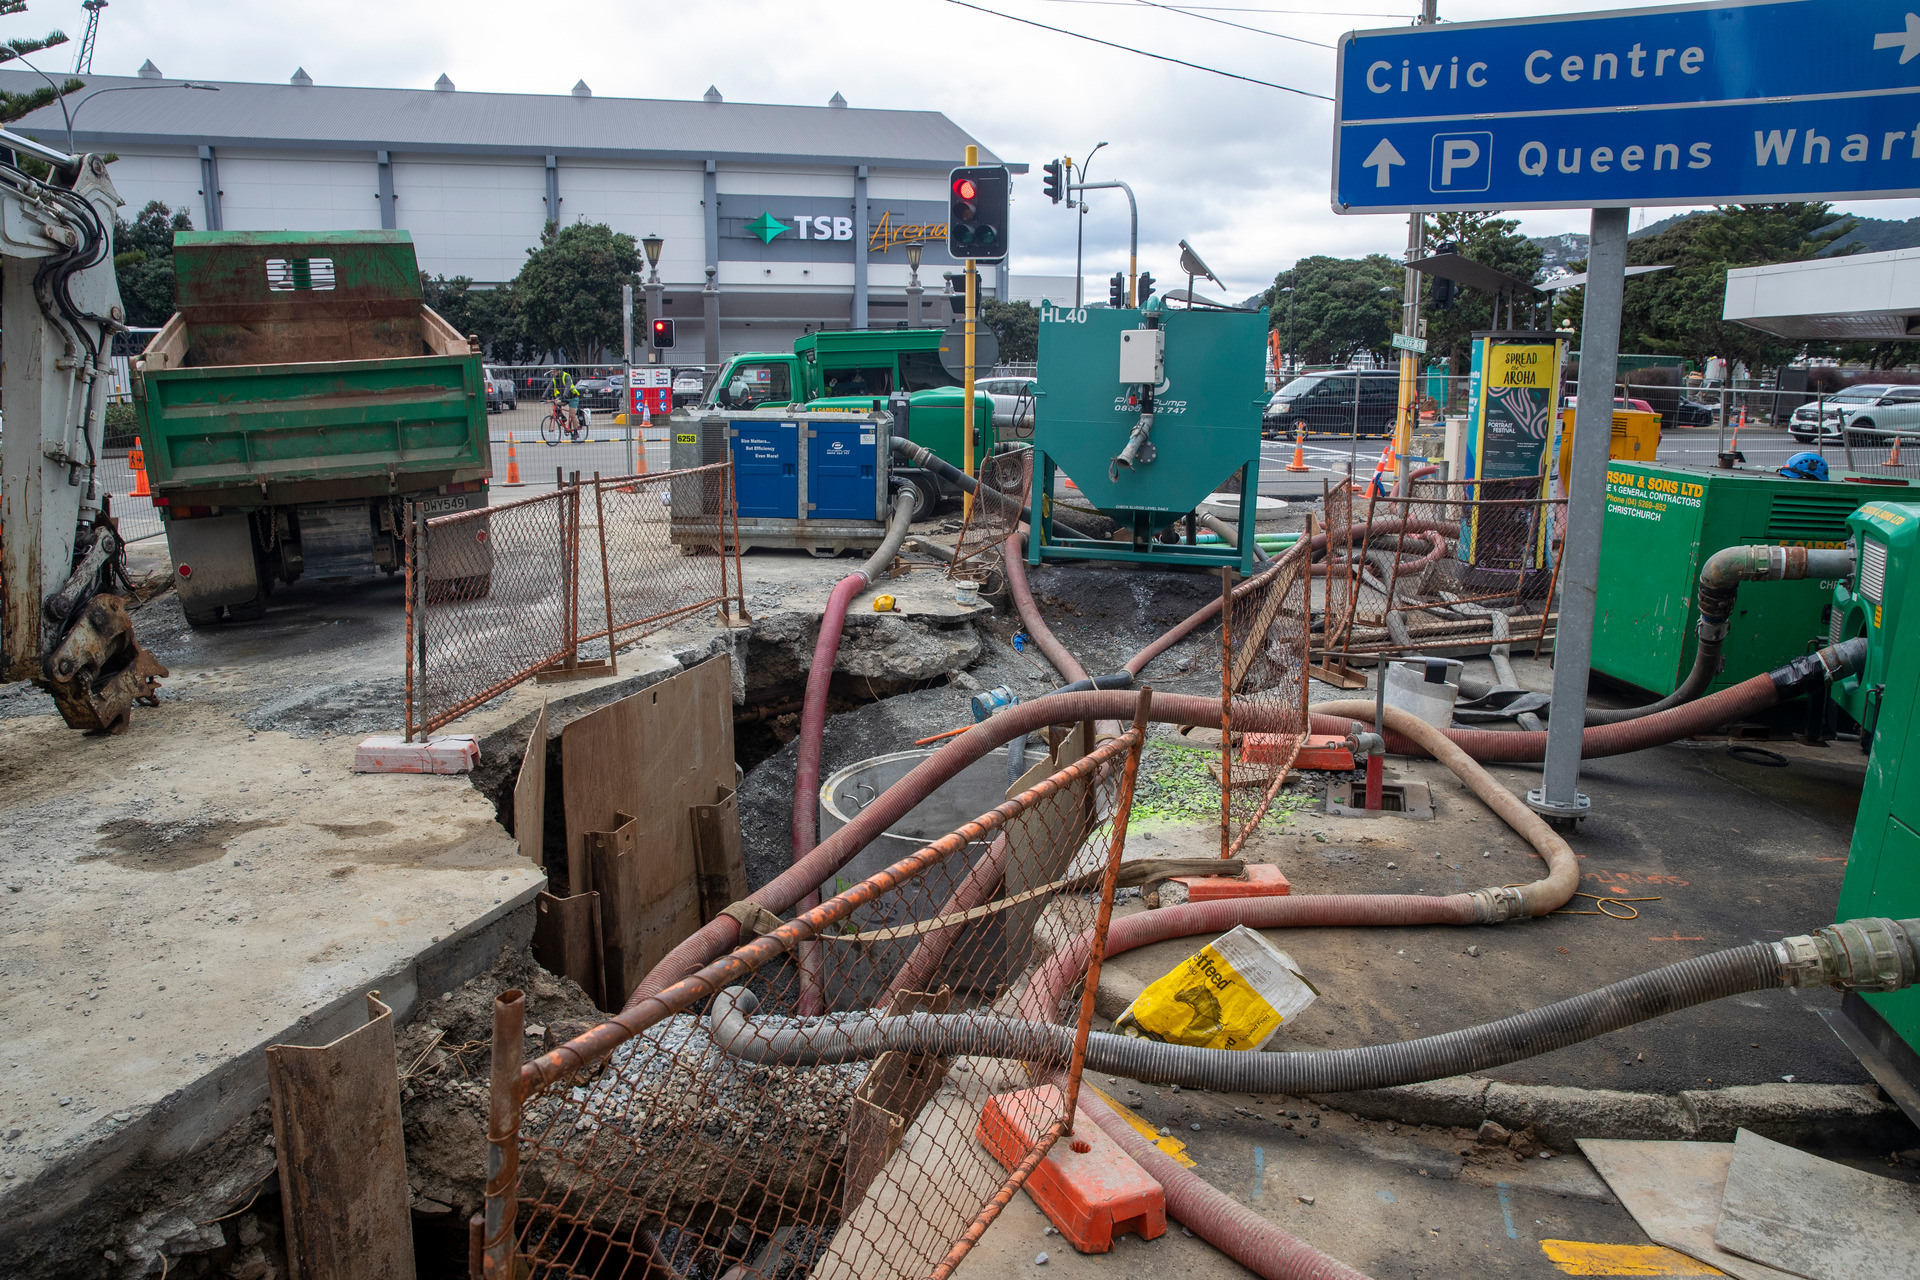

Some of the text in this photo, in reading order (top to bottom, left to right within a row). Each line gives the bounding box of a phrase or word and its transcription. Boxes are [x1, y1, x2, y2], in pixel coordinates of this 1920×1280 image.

[1366, 43, 1706, 94] Civic Centre
[1441, 139, 1480, 186] P
[1518, 140, 1712, 178] Queens
[793, 210, 949, 254] TSB Arena
[1041, 307, 1088, 324] HL40
[1505, 352, 1538, 367] SPREAD
[1503, 370, 1536, 385] AROHA
[677, 435, 696, 443] 6258
[1606, 470, 1703, 498] RSON & SONS LTD
[424, 498, 464, 512] DWY549
[1606, 493, 1624, 504] Phone
[1625, 497, 1637, 507] (04)
[1618, 486, 1648, 498] GENERAL
[1649, 491, 1701, 508] CONTRACTORS
[1607, 503, 1661, 522] CHRISTCHURCH
[1889, 515, 1905, 525] LTD
[1193, 951, 1233, 991] etfeed
